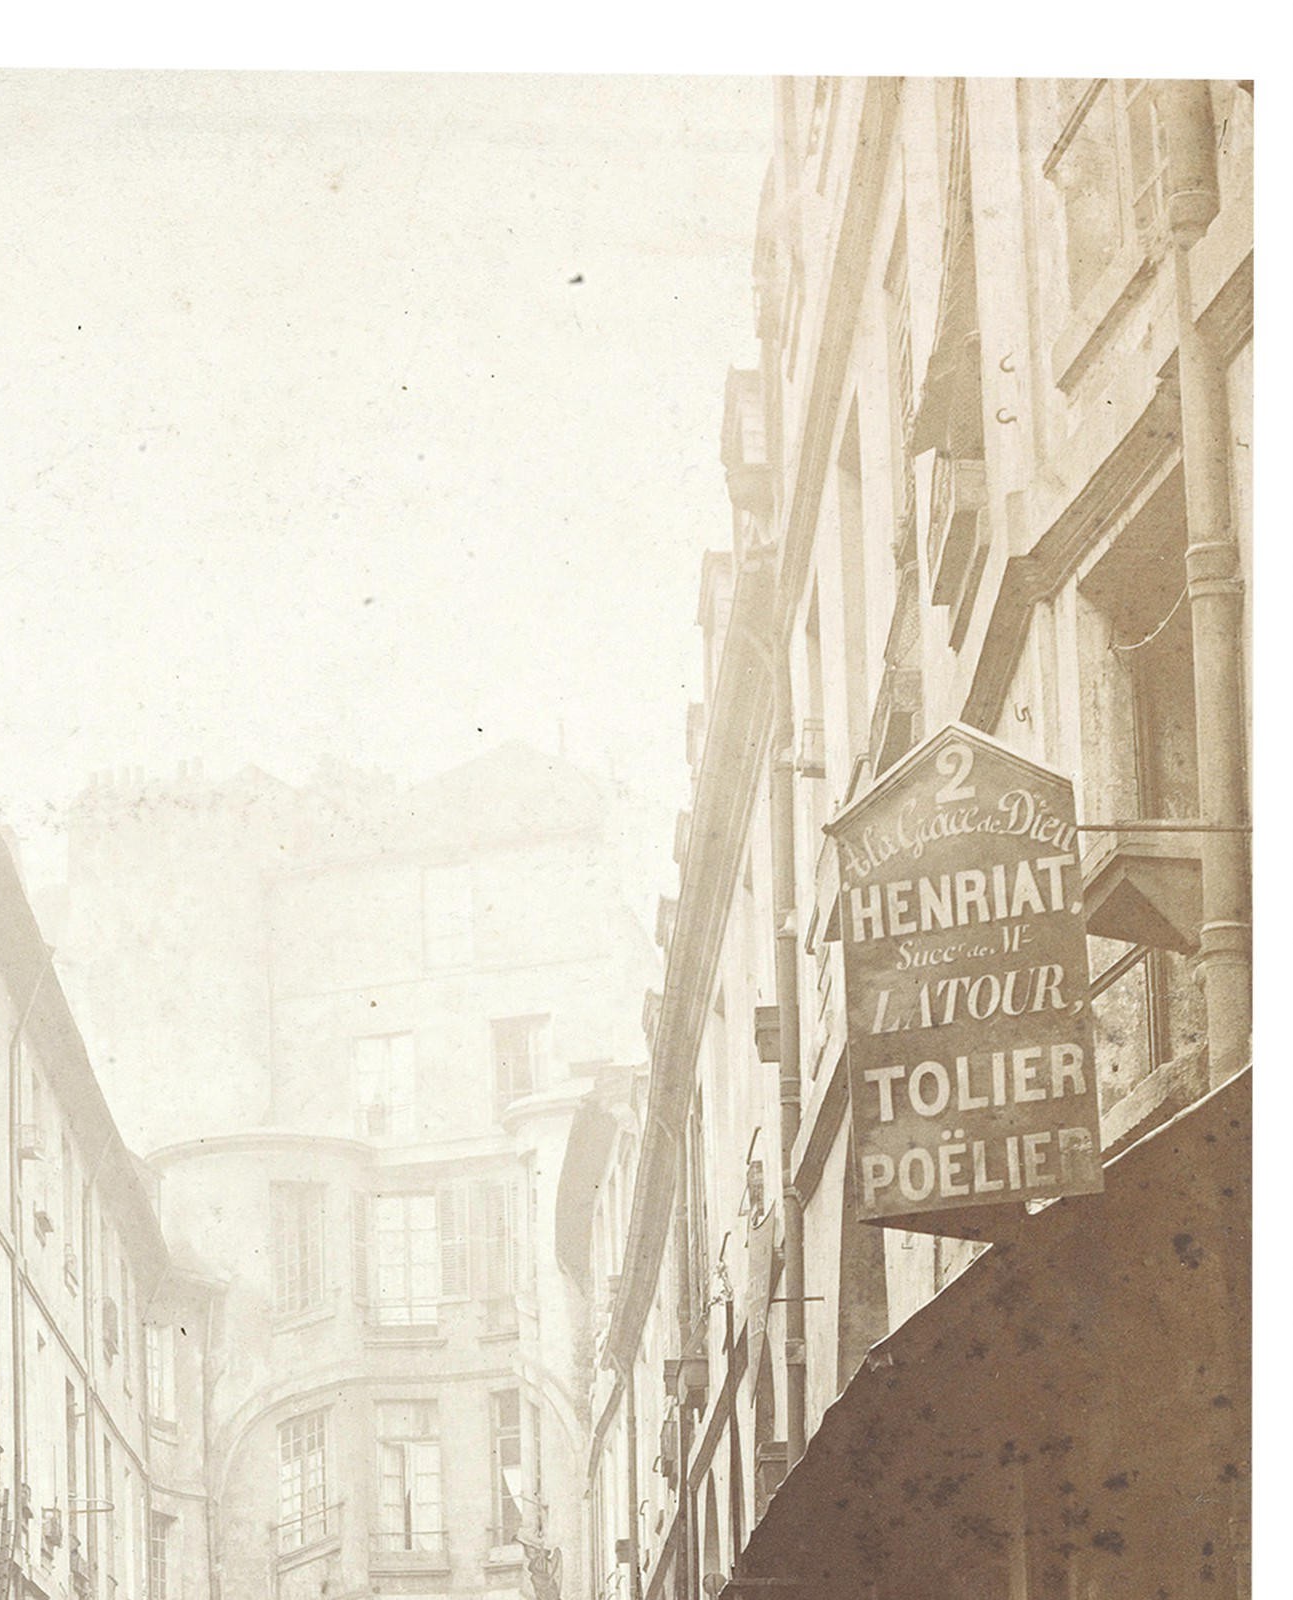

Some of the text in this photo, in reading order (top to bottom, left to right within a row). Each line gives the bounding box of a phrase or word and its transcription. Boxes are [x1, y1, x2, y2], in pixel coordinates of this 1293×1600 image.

[935, 744, 976, 803] 2
[997, 789, 1079, 852] Dieu
[864, 1043, 1087, 1122] TOLIER
